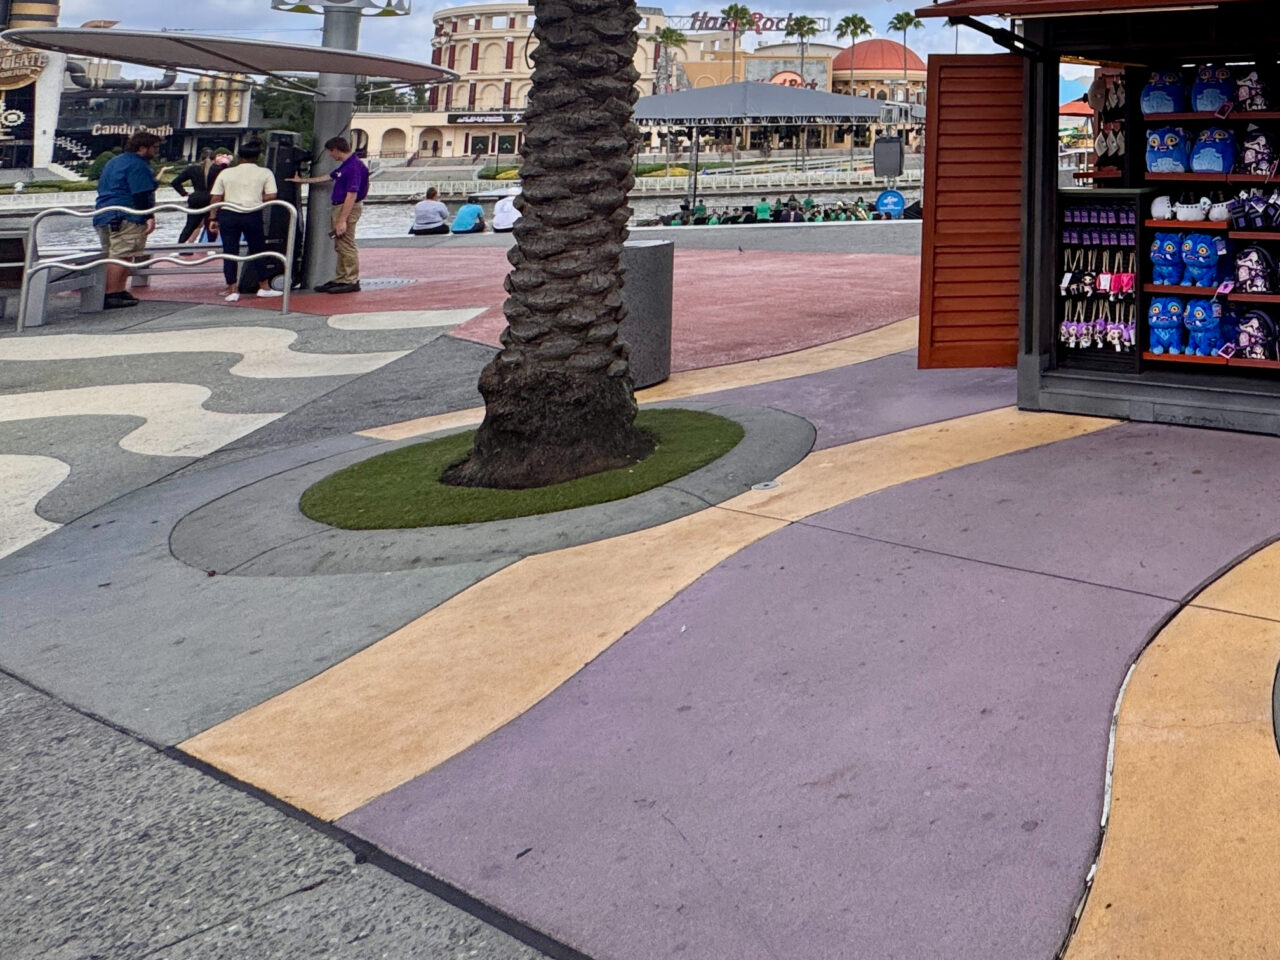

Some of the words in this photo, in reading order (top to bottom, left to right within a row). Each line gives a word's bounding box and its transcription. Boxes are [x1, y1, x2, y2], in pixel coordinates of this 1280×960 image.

[748, 12, 796, 35] Rock
[0, 52, 49, 70] OLATE
[92, 123, 135, 138] Candy
[139, 124, 174, 138] Smith
